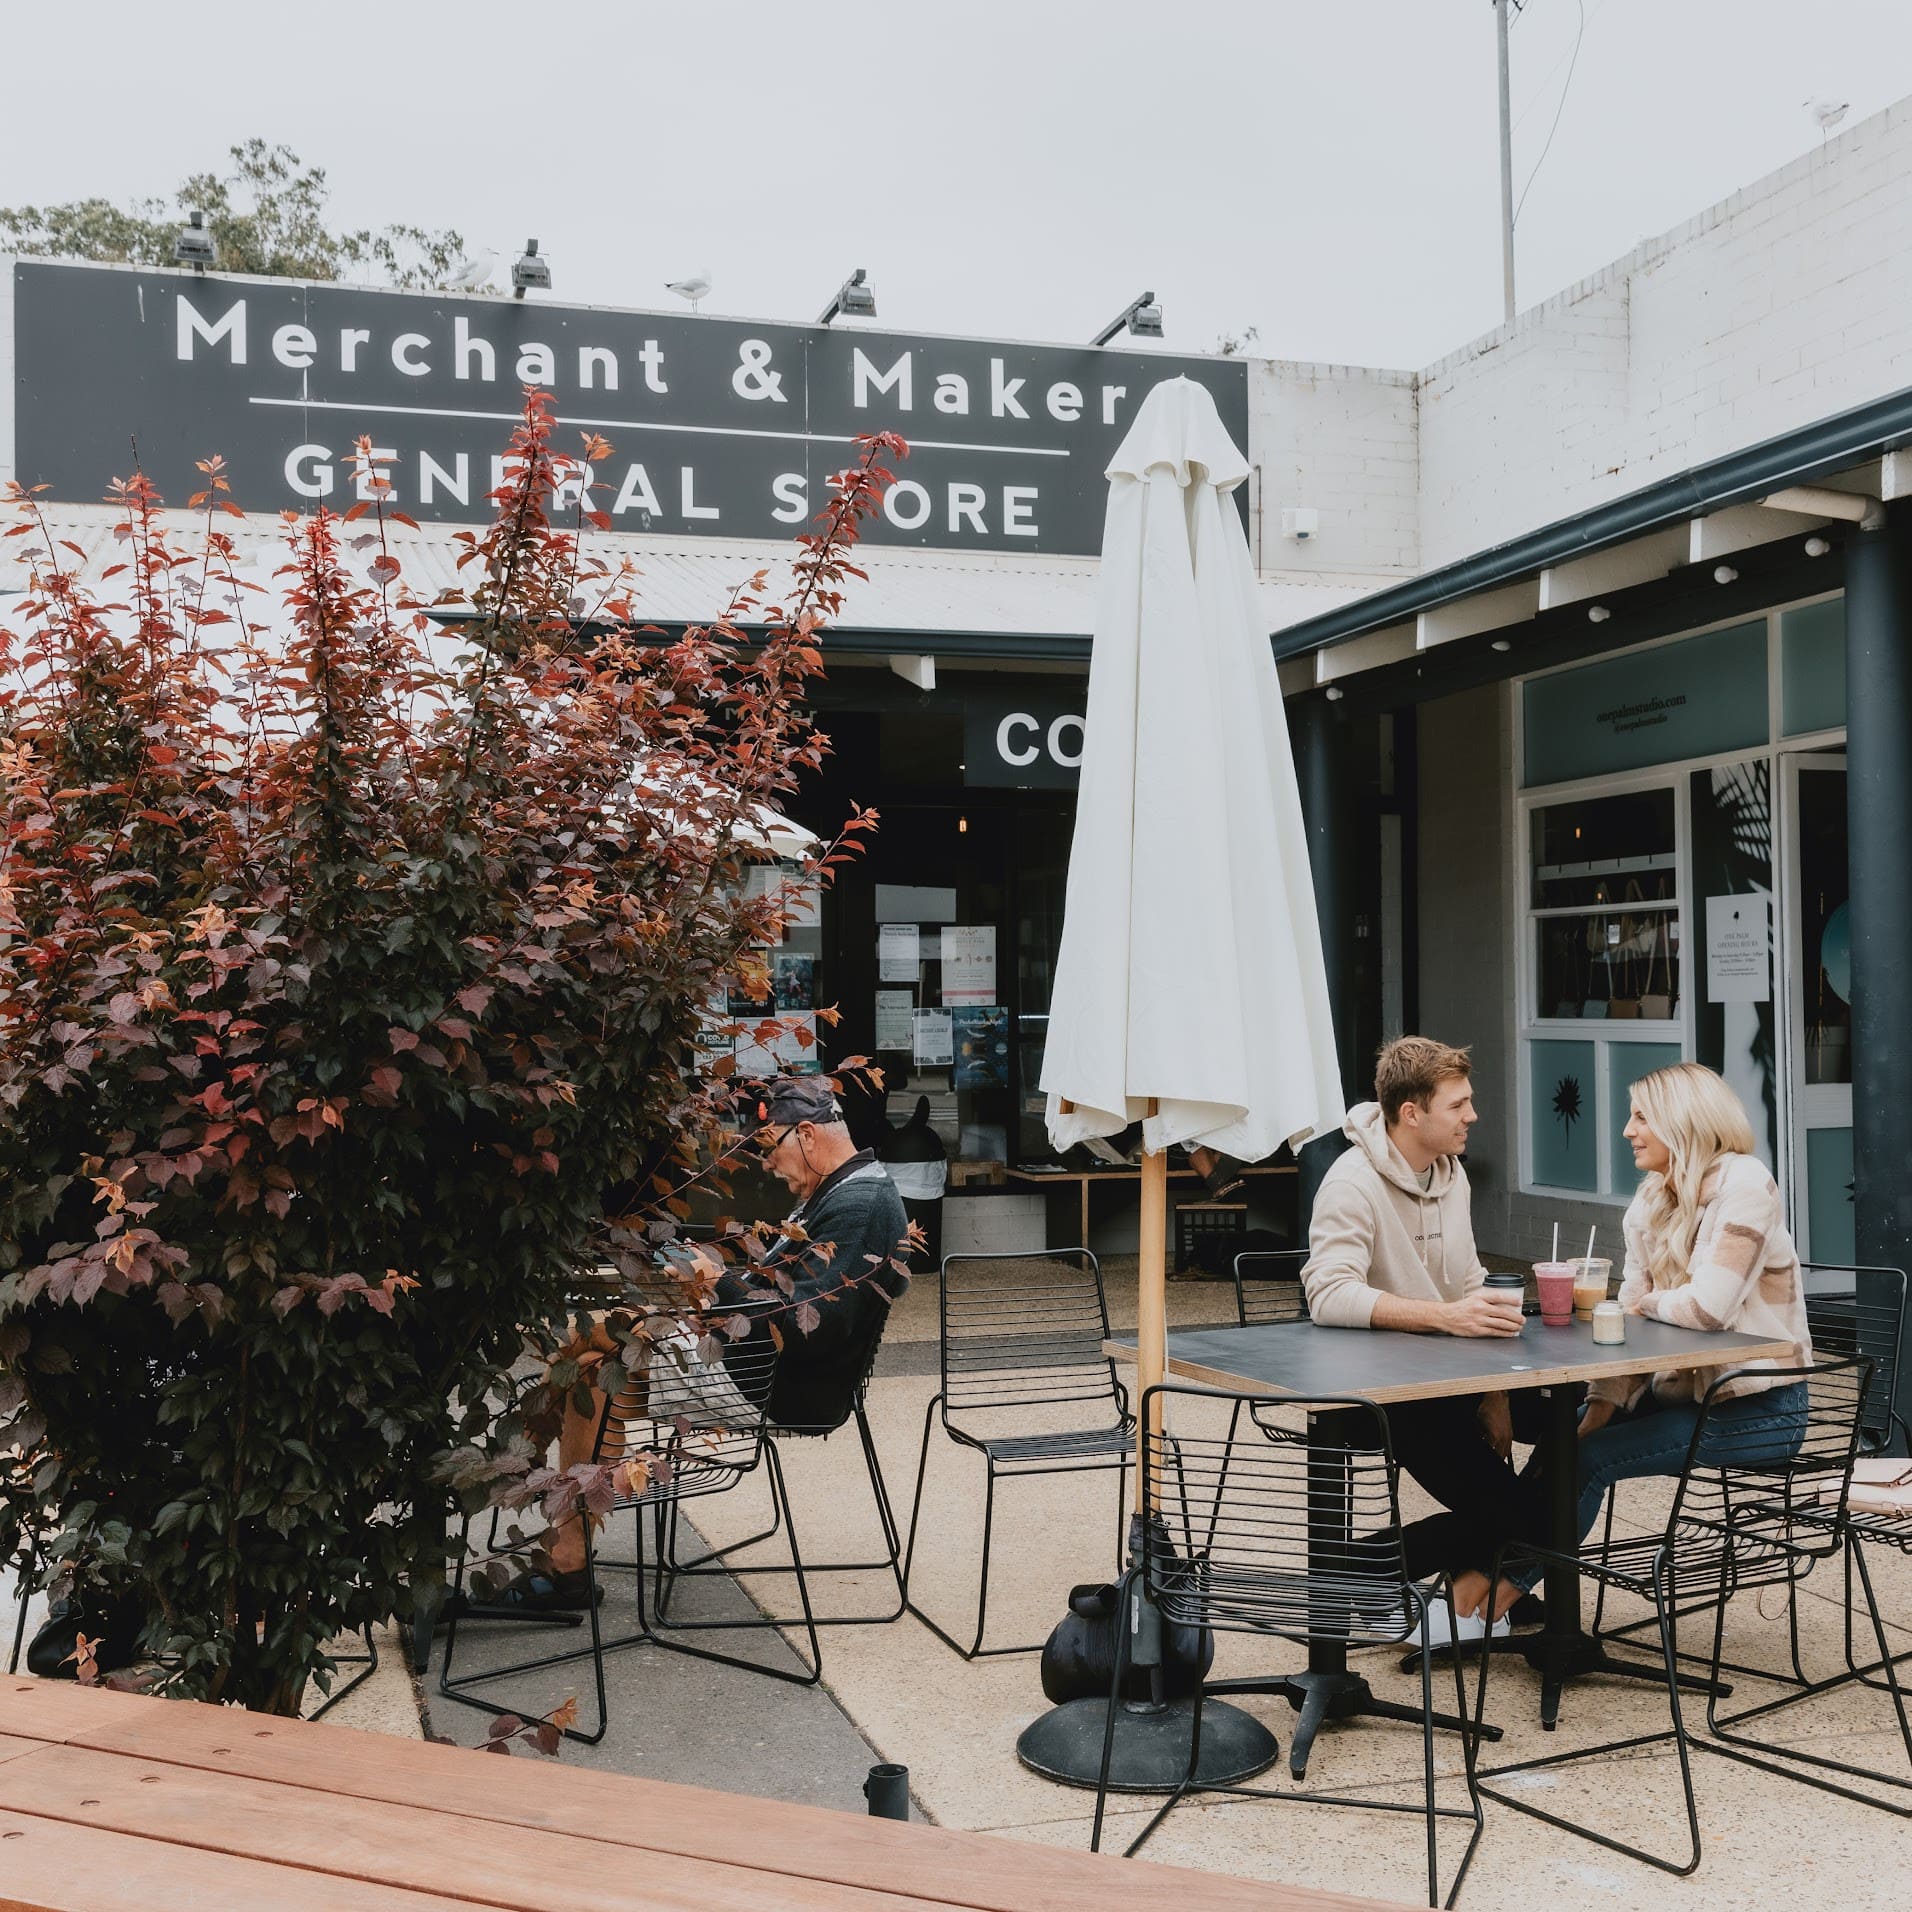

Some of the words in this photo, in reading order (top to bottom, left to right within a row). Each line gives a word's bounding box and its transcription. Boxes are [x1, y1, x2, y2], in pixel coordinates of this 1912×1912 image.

[176, 294, 669, 394] Merchant
[732, 339, 789, 403] &
[1596, 694, 1687, 723] onepalmstudio.com
